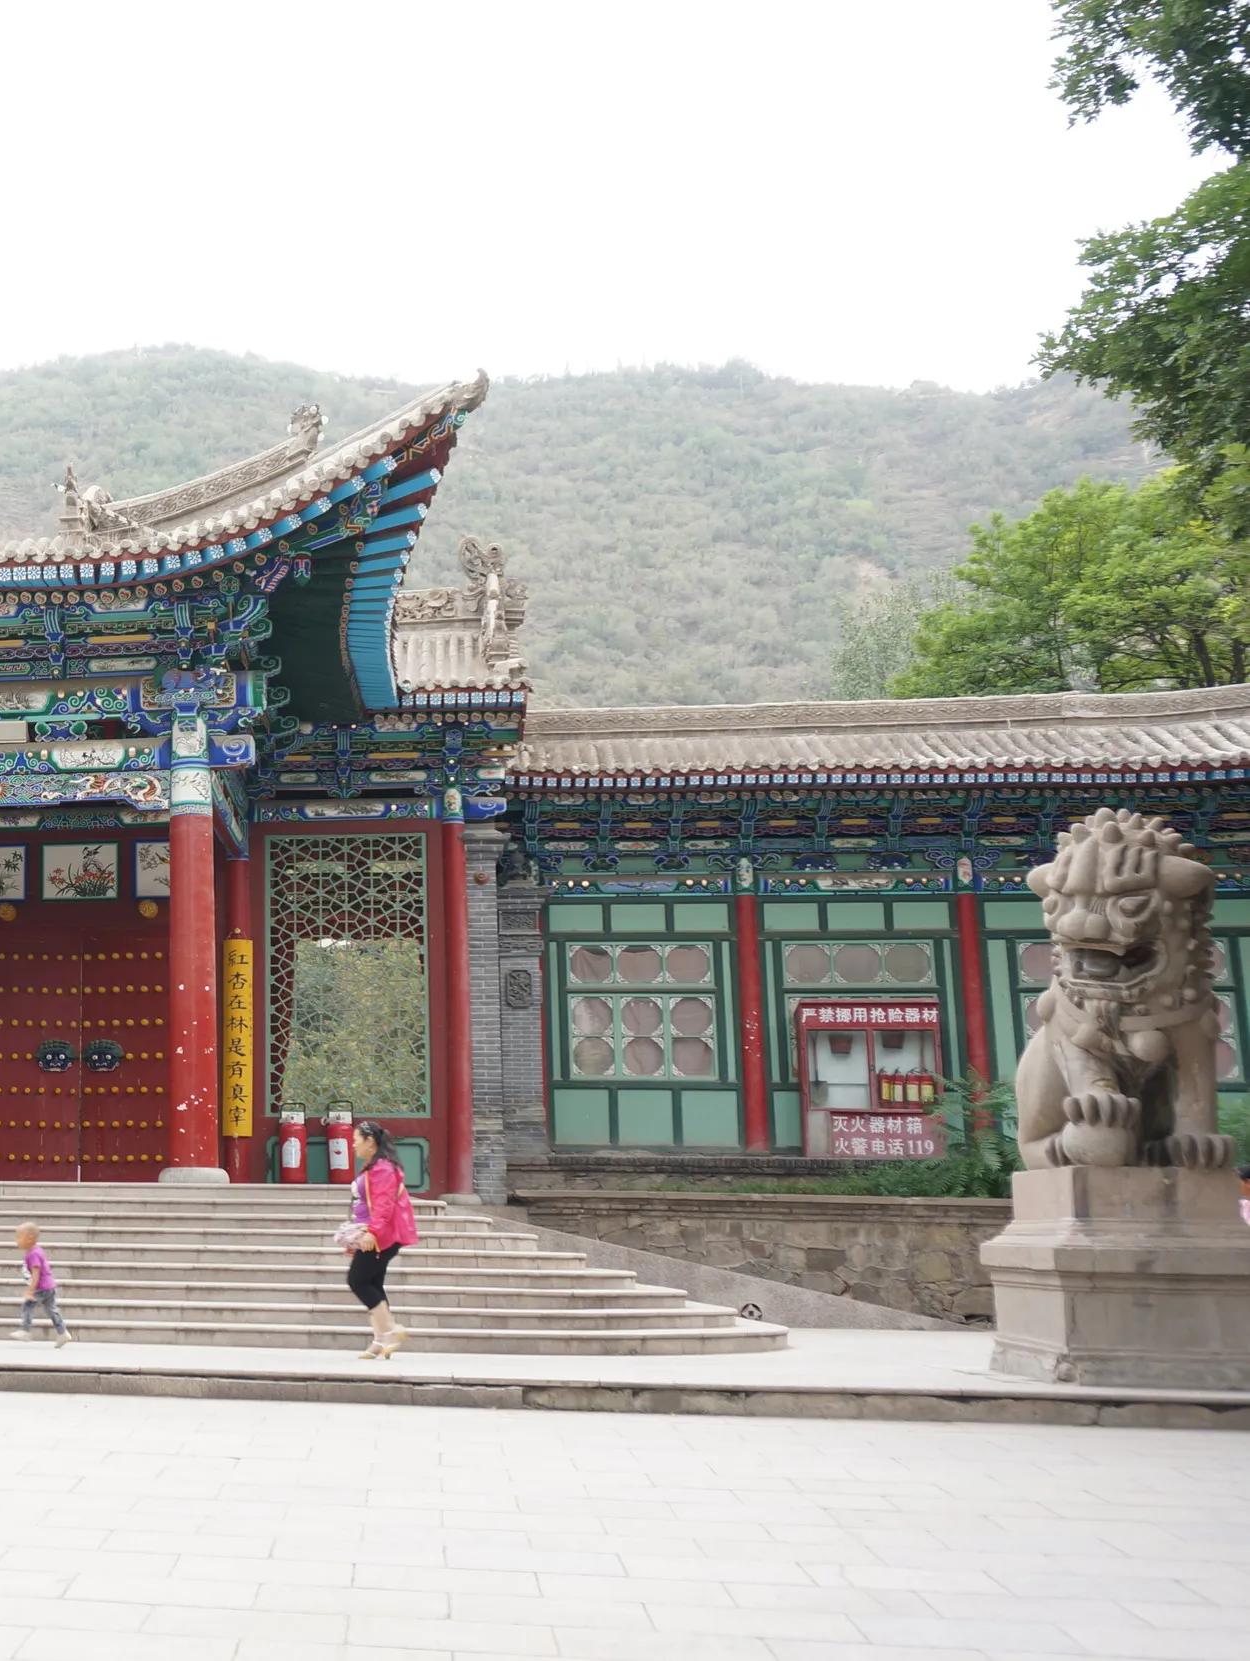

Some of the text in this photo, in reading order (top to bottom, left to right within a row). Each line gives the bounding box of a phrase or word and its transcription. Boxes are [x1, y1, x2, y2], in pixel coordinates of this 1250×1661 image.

[801, 1007, 939, 1023] 严禁挪用抢险器材
[832, 1116, 923, 1134] 灭火器材箱
[834, 1138, 934, 1155] 火警电话119
